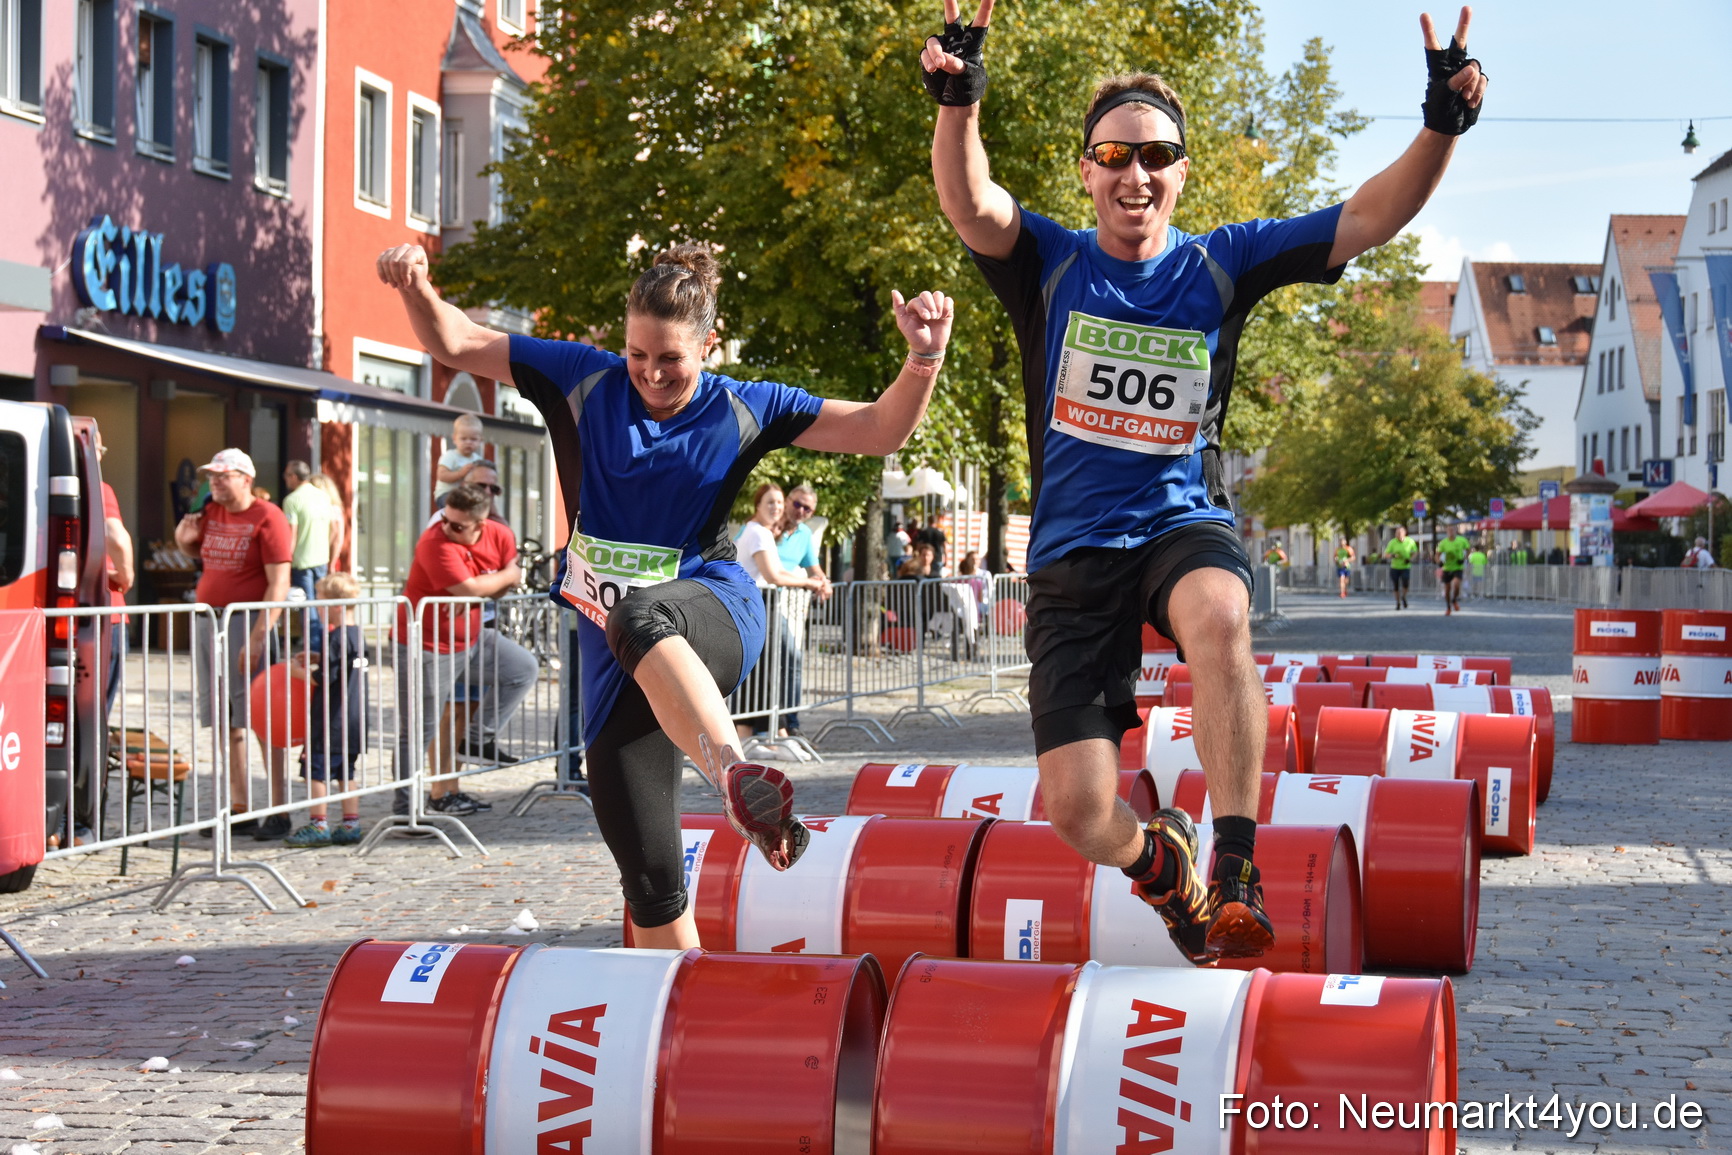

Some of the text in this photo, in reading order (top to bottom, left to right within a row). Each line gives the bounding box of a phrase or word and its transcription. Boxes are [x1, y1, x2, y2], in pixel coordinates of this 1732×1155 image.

[1077, 321, 1198, 363] BOCK
[1086, 363, 1177, 411] 506
[1067, 404, 1184, 440] WOLFGANG
[583, 569, 646, 613] 50
[1410, 714, 1440, 763] AVIA
[1033, 920, 1041, 960] energie
[813, 986, 829, 1006] 323
